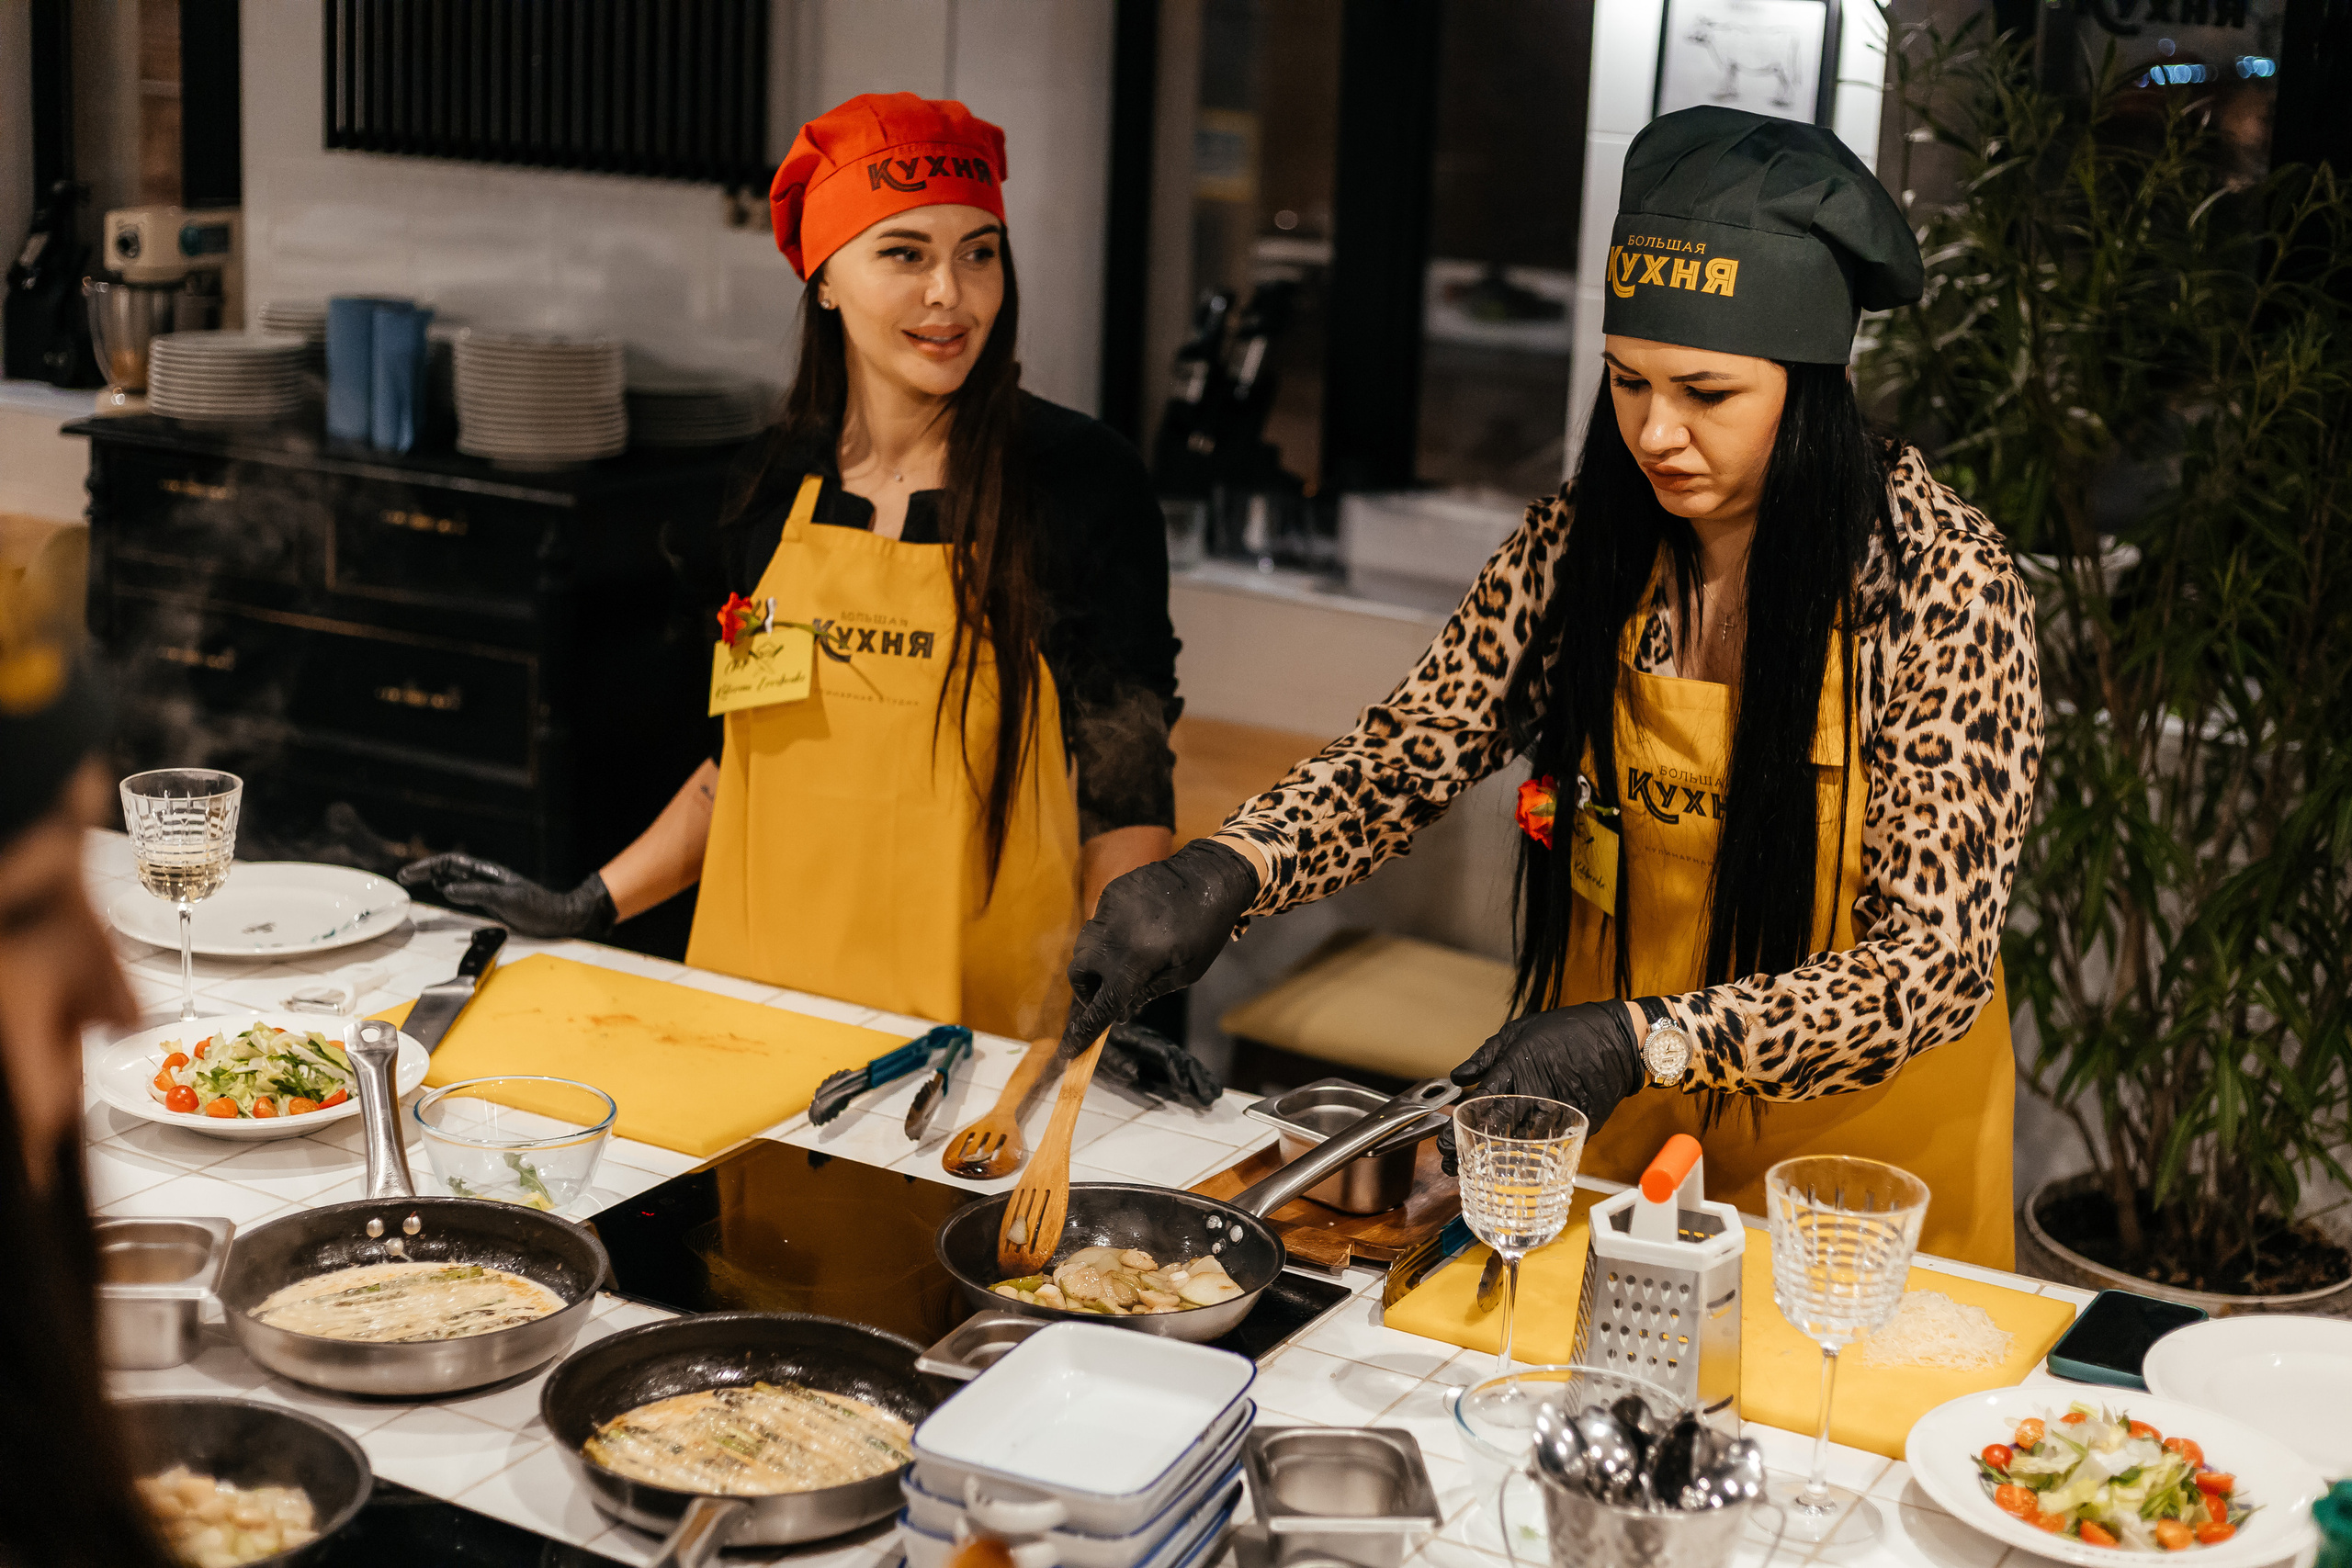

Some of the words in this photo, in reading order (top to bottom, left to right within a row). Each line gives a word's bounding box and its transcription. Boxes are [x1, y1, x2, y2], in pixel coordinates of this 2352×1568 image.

[867, 155, 993, 192] КУХНЯ
[1628, 234, 1706, 254] БОЛЬШАЯ
[1607, 245, 1739, 299] КУХНЯ
[813, 618, 934, 662] КУХНЯ
[1627, 767, 1727, 825] КУХН
[1659, 765, 1724, 788] БОЛЬША
